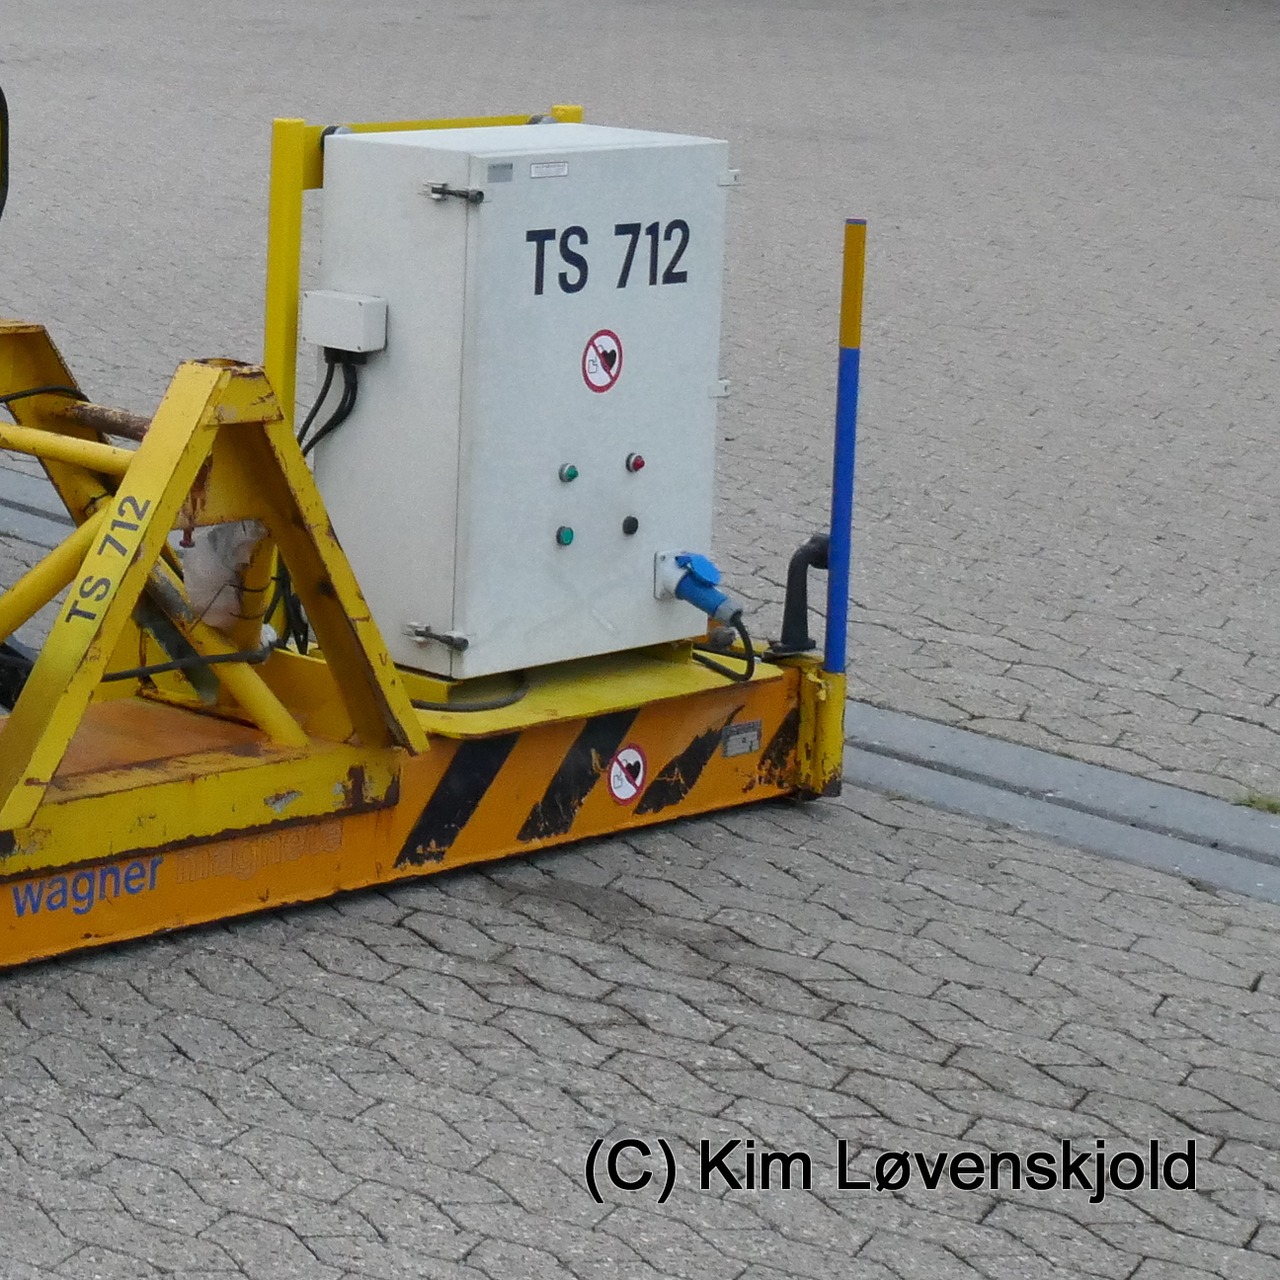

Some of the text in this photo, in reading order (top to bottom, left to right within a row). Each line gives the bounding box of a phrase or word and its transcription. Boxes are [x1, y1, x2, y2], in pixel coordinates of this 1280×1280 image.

[525, 218, 690, 296] TS 712
[65, 495, 151, 623] TS 712
[12, 856, 164, 917] wagner
